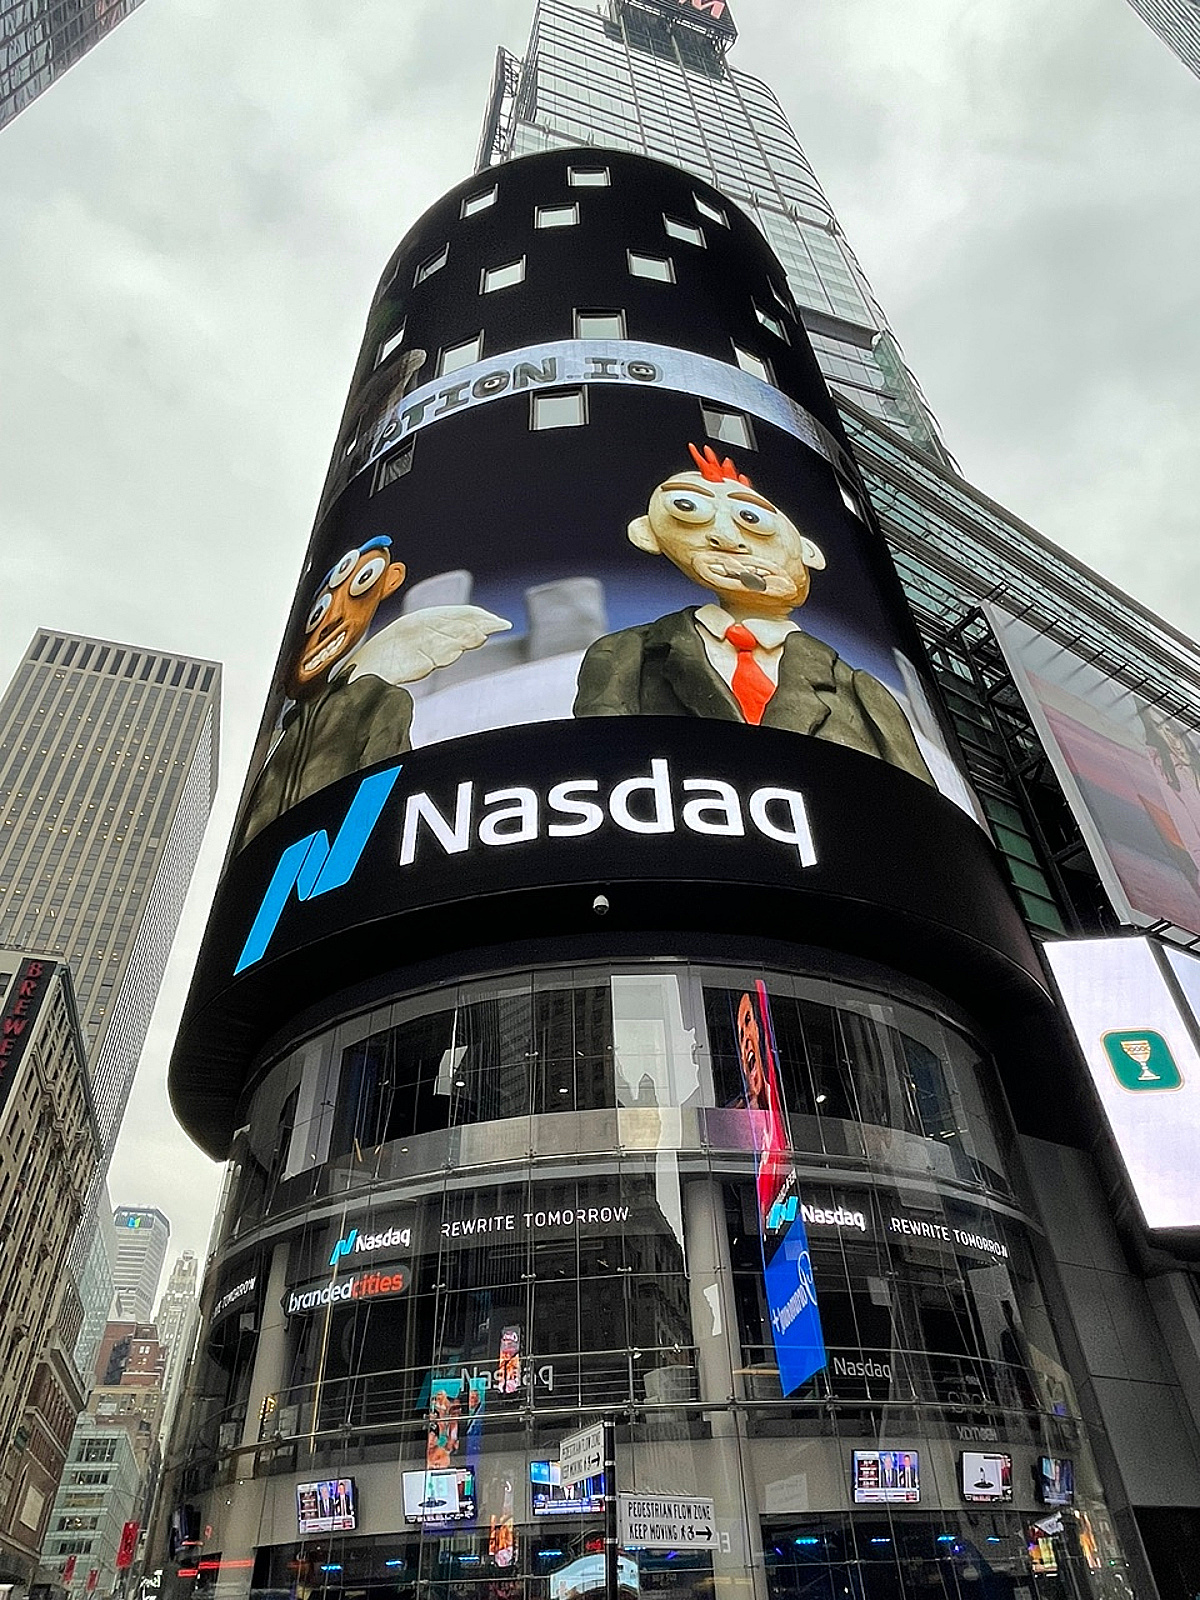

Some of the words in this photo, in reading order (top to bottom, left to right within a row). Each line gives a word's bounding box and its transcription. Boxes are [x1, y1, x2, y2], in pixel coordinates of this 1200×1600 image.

[399, 758, 818, 868] Nasdaq
[440, 1214, 515, 1238] REWRITE
[523, 1206, 630, 1228] TOMORROW
[801, 1204, 866, 1232] Nasdaq
[891, 1217, 951, 1242] REWRITE
[354, 1227, 411, 1253] Nasdaq
[460, 1364, 554, 1392] Nasaq
[833, 1357, 894, 1384] Nasdaq
[628, 1501, 673, 1519] PEDESTRIAN
[673, 1504, 693, 1520] FLOW
[694, 1504, 712, 1521] ZONE
[629, 1523, 648, 1540] KEEP
[649, 1524, 678, 1541] MOVING
